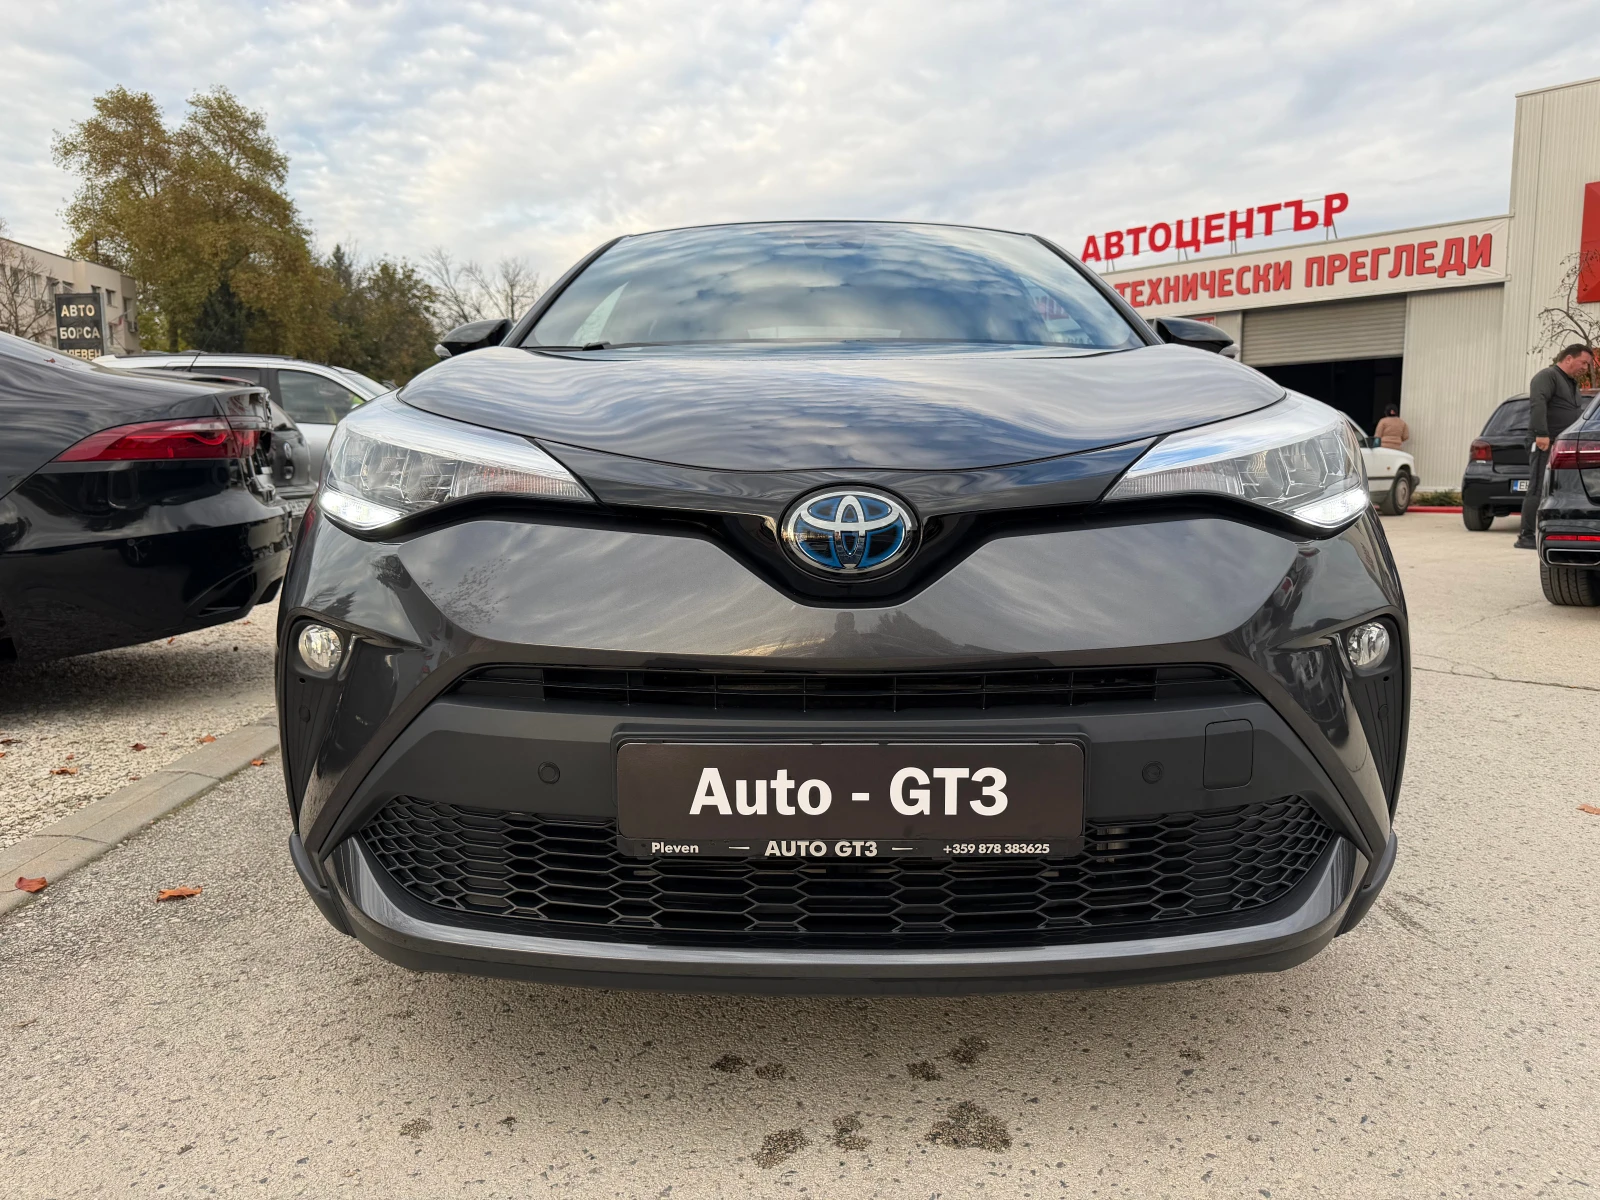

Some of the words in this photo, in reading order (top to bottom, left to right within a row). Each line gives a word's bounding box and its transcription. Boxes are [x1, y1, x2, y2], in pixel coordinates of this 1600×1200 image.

[1081, 192, 1349, 263] АВТОЦЕНТЪР
[1114, 260, 1292, 308] ТЕХНИЧЕСКИ
[1304, 233, 1492, 288] ПРЕГЛЕДИ
[61, 304, 95, 317] АВТО
[60, 326, 100, 339] БОРСА
[64, 349, 101, 360] ЛЕВЕН
[689, 767, 832, 816] Auto
[889, 767, 1008, 816] GT3
[651, 842, 699, 854] Pleven
[764, 840, 827, 857] AUTO
[834, 841, 878, 857] GT3
[943, 843, 976, 854] +359
[978, 843, 1002, 854] 878
[1004, 843, 1050, 854] 383625
